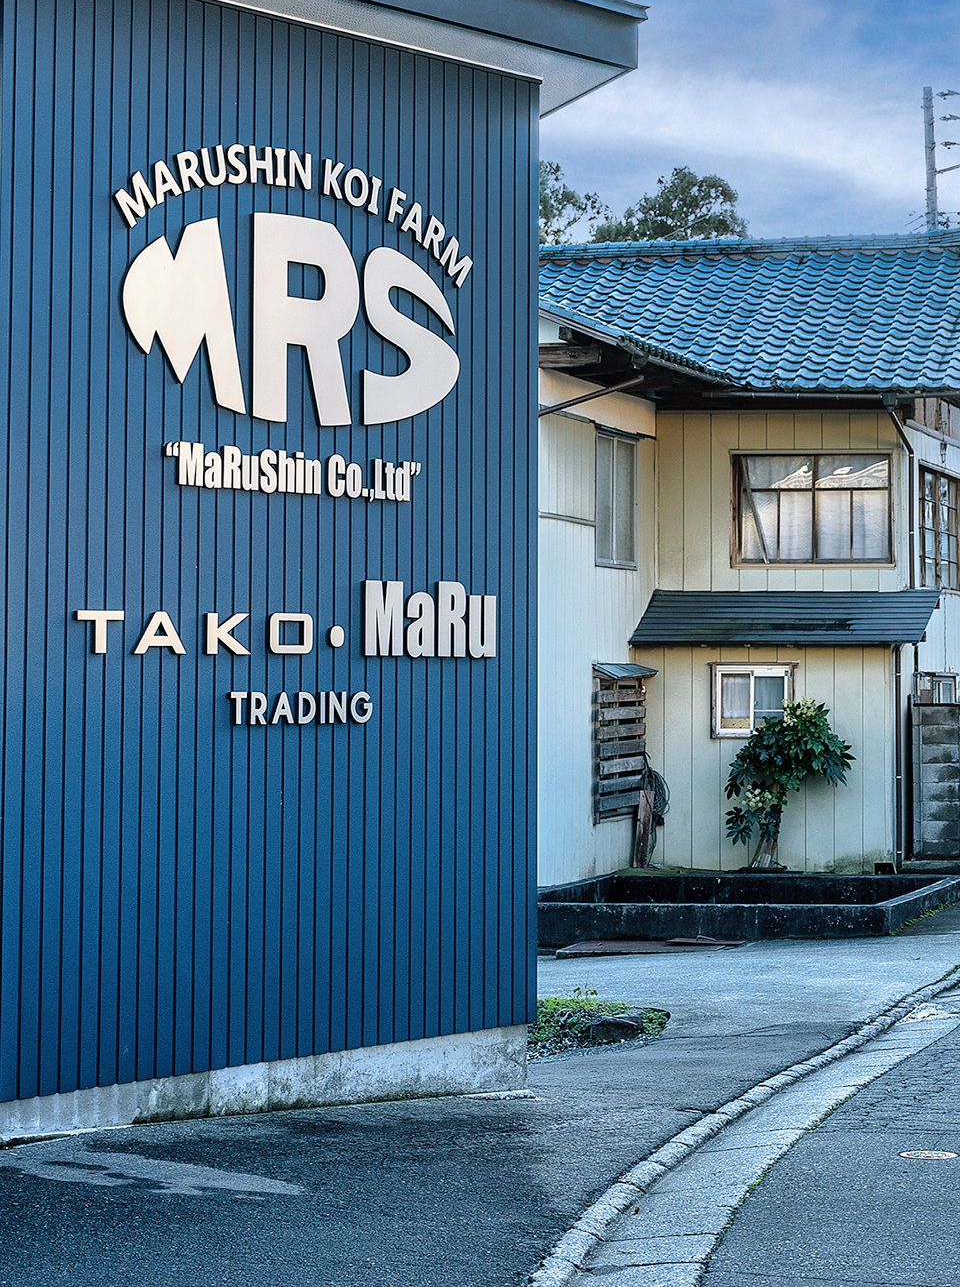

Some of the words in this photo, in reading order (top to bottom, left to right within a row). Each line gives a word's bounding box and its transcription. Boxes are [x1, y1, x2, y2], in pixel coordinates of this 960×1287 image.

[114, 144, 313, 228] MARUSHIN
[322, 158, 383, 216] KOI
[387, 186, 474, 289] FARM
[122, 212, 460, 427] MRS
[364, 580, 497, 659] MaRu
[230, 691, 373, 725] TRADING
